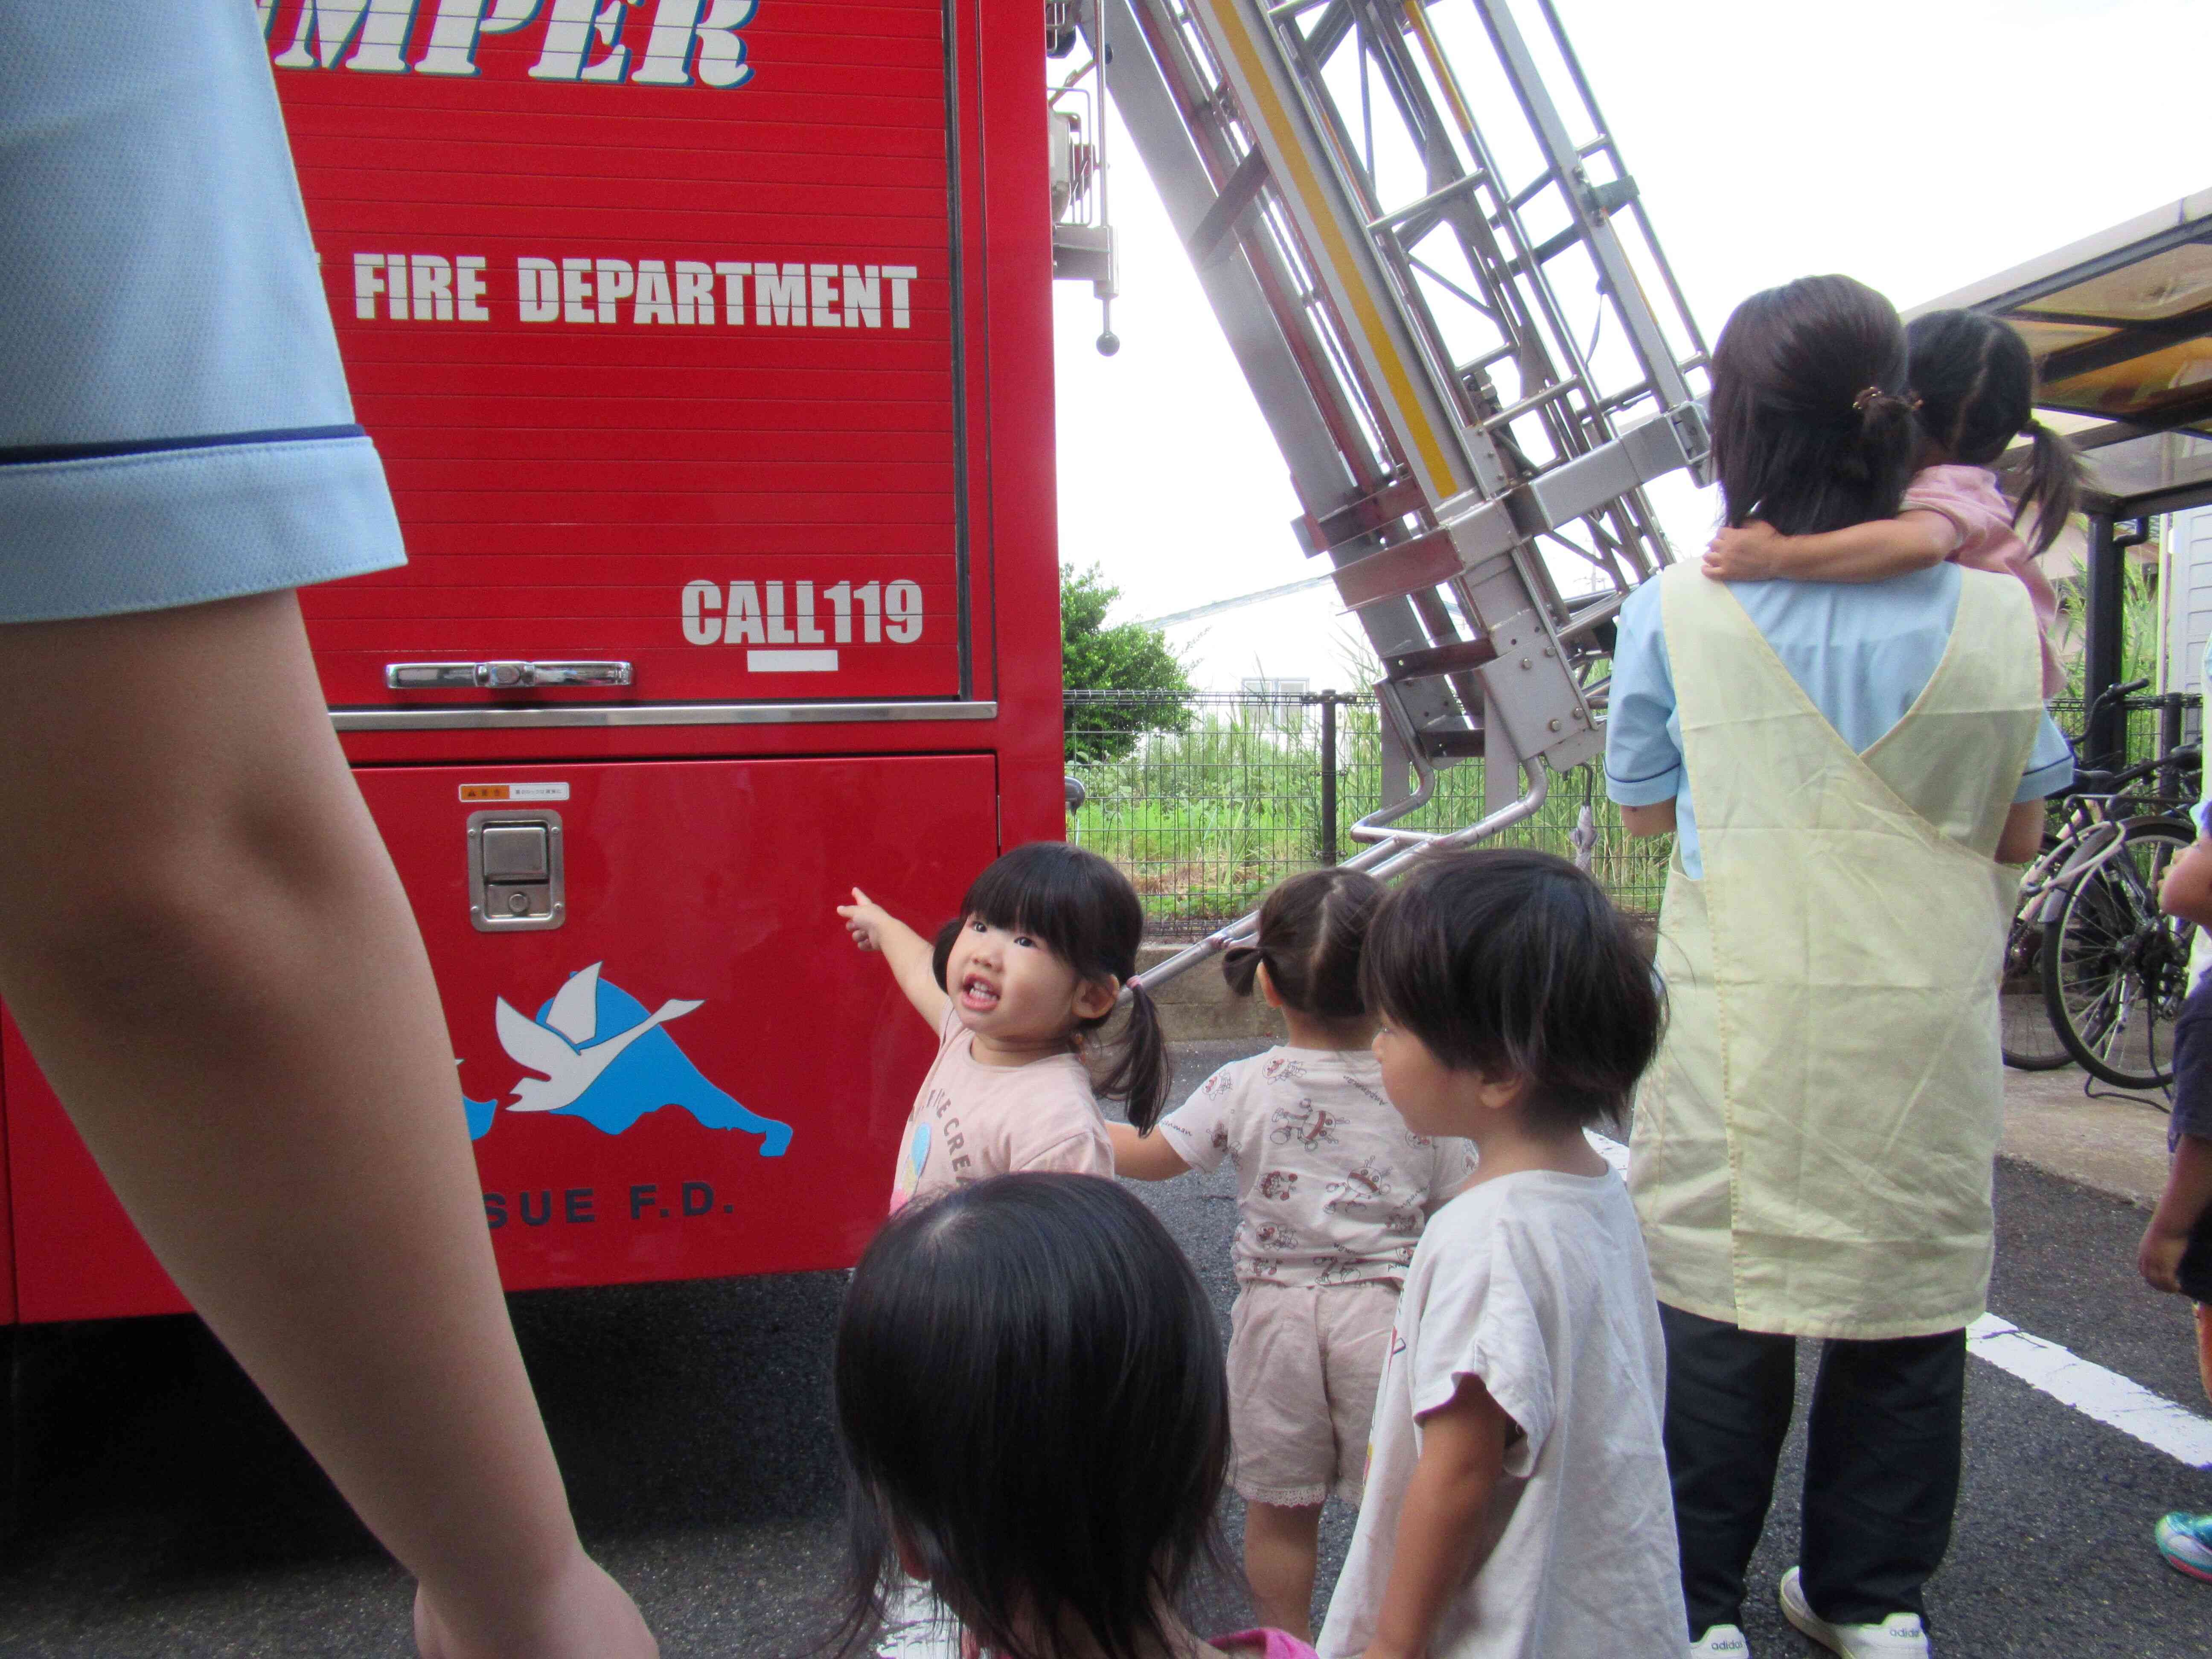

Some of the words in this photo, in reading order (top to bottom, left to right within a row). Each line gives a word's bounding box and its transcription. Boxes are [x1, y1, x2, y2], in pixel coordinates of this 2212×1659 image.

[254, 0, 756, 88] MPER
[354, 253, 489, 321] FIRE
[517, 257, 917, 329] DEPARTMENT
[629, 1180, 733, 1220] F.D.
